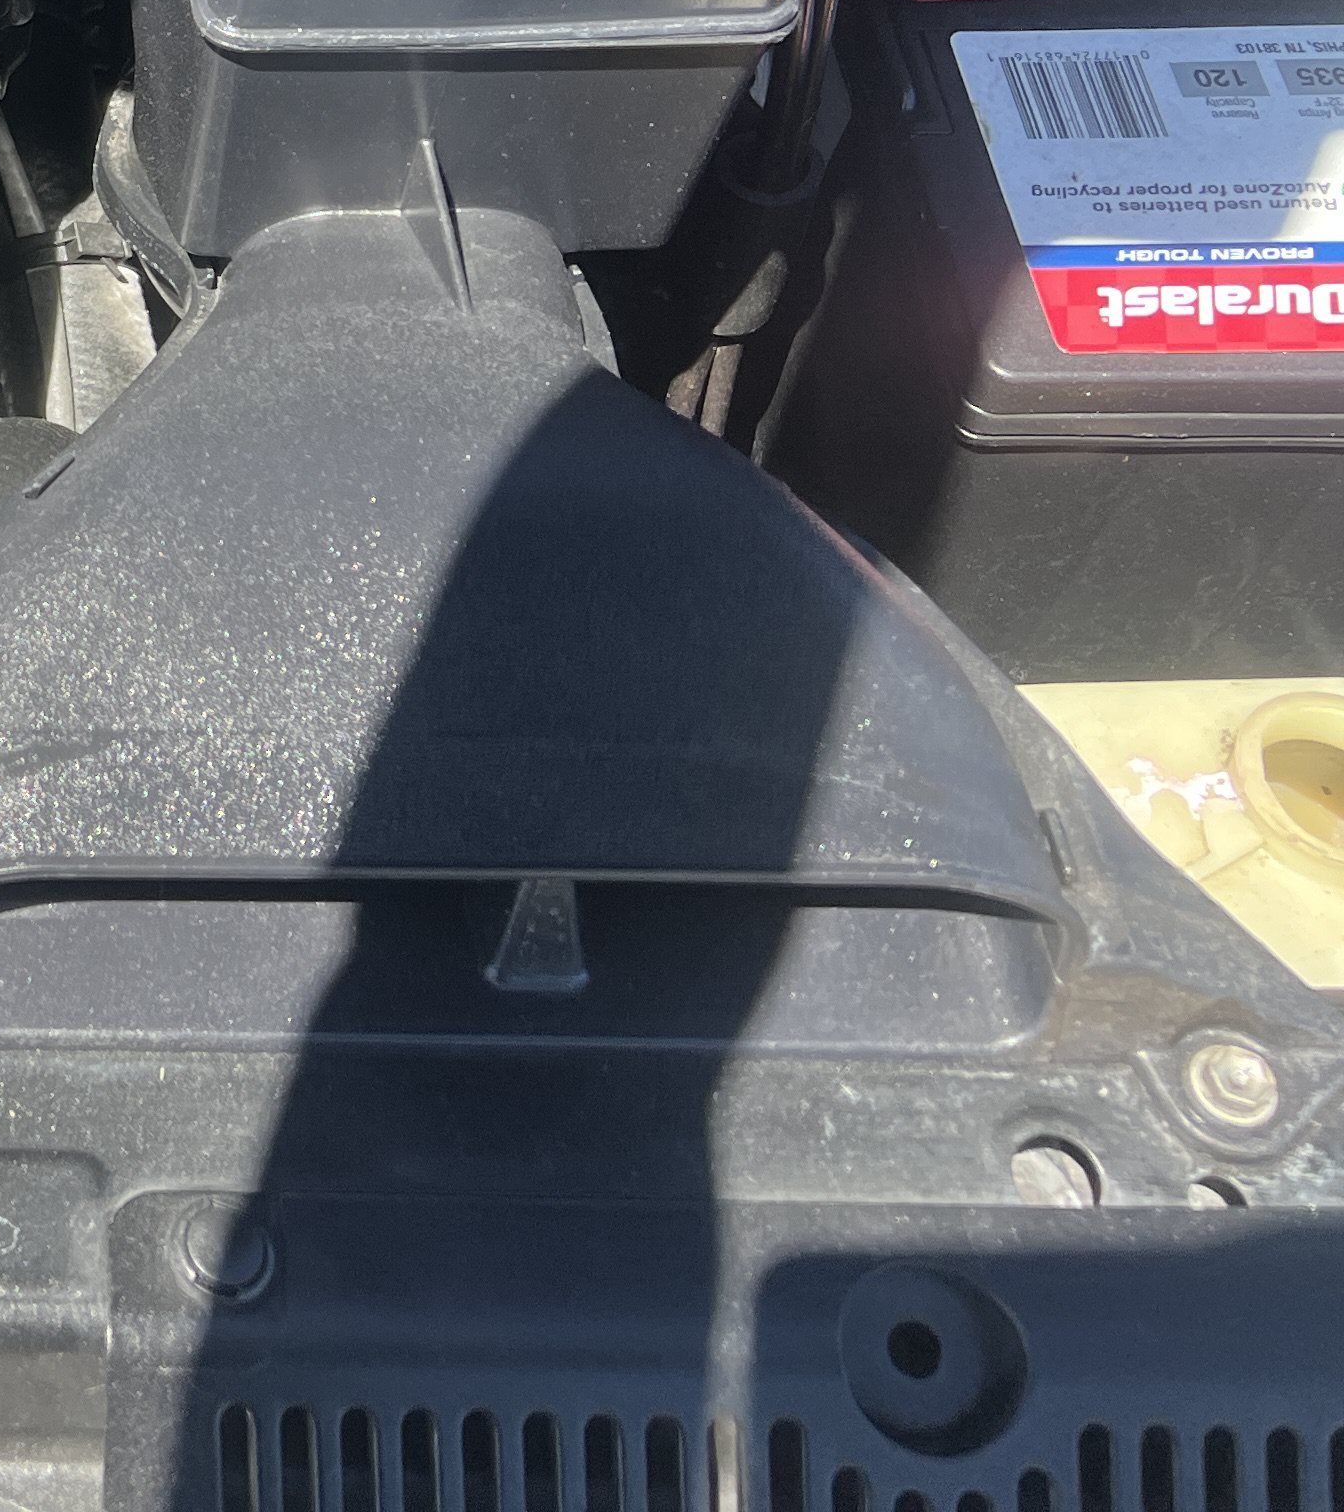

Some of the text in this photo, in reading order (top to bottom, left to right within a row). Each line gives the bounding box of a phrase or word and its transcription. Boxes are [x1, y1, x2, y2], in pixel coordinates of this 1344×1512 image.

[1236, 39, 1344, 54] PHIS, TN 38103
[1140, 50, 1150, 60] 0
[1193, 68, 1247, 88] 120
[1296, 67, 1344, 86] 935
[1206, 96, 1256, 107] Capacity
[1212, 109, 1260, 120] Reserve
[1031, 181, 1331, 199] AutoZone for proper recycling
[1092, 197, 1337, 214] Return used batteries to
[1118, 246, 1314, 262] PROVEN TOUGH
[1096, 283, 1344, 327] Duralast
